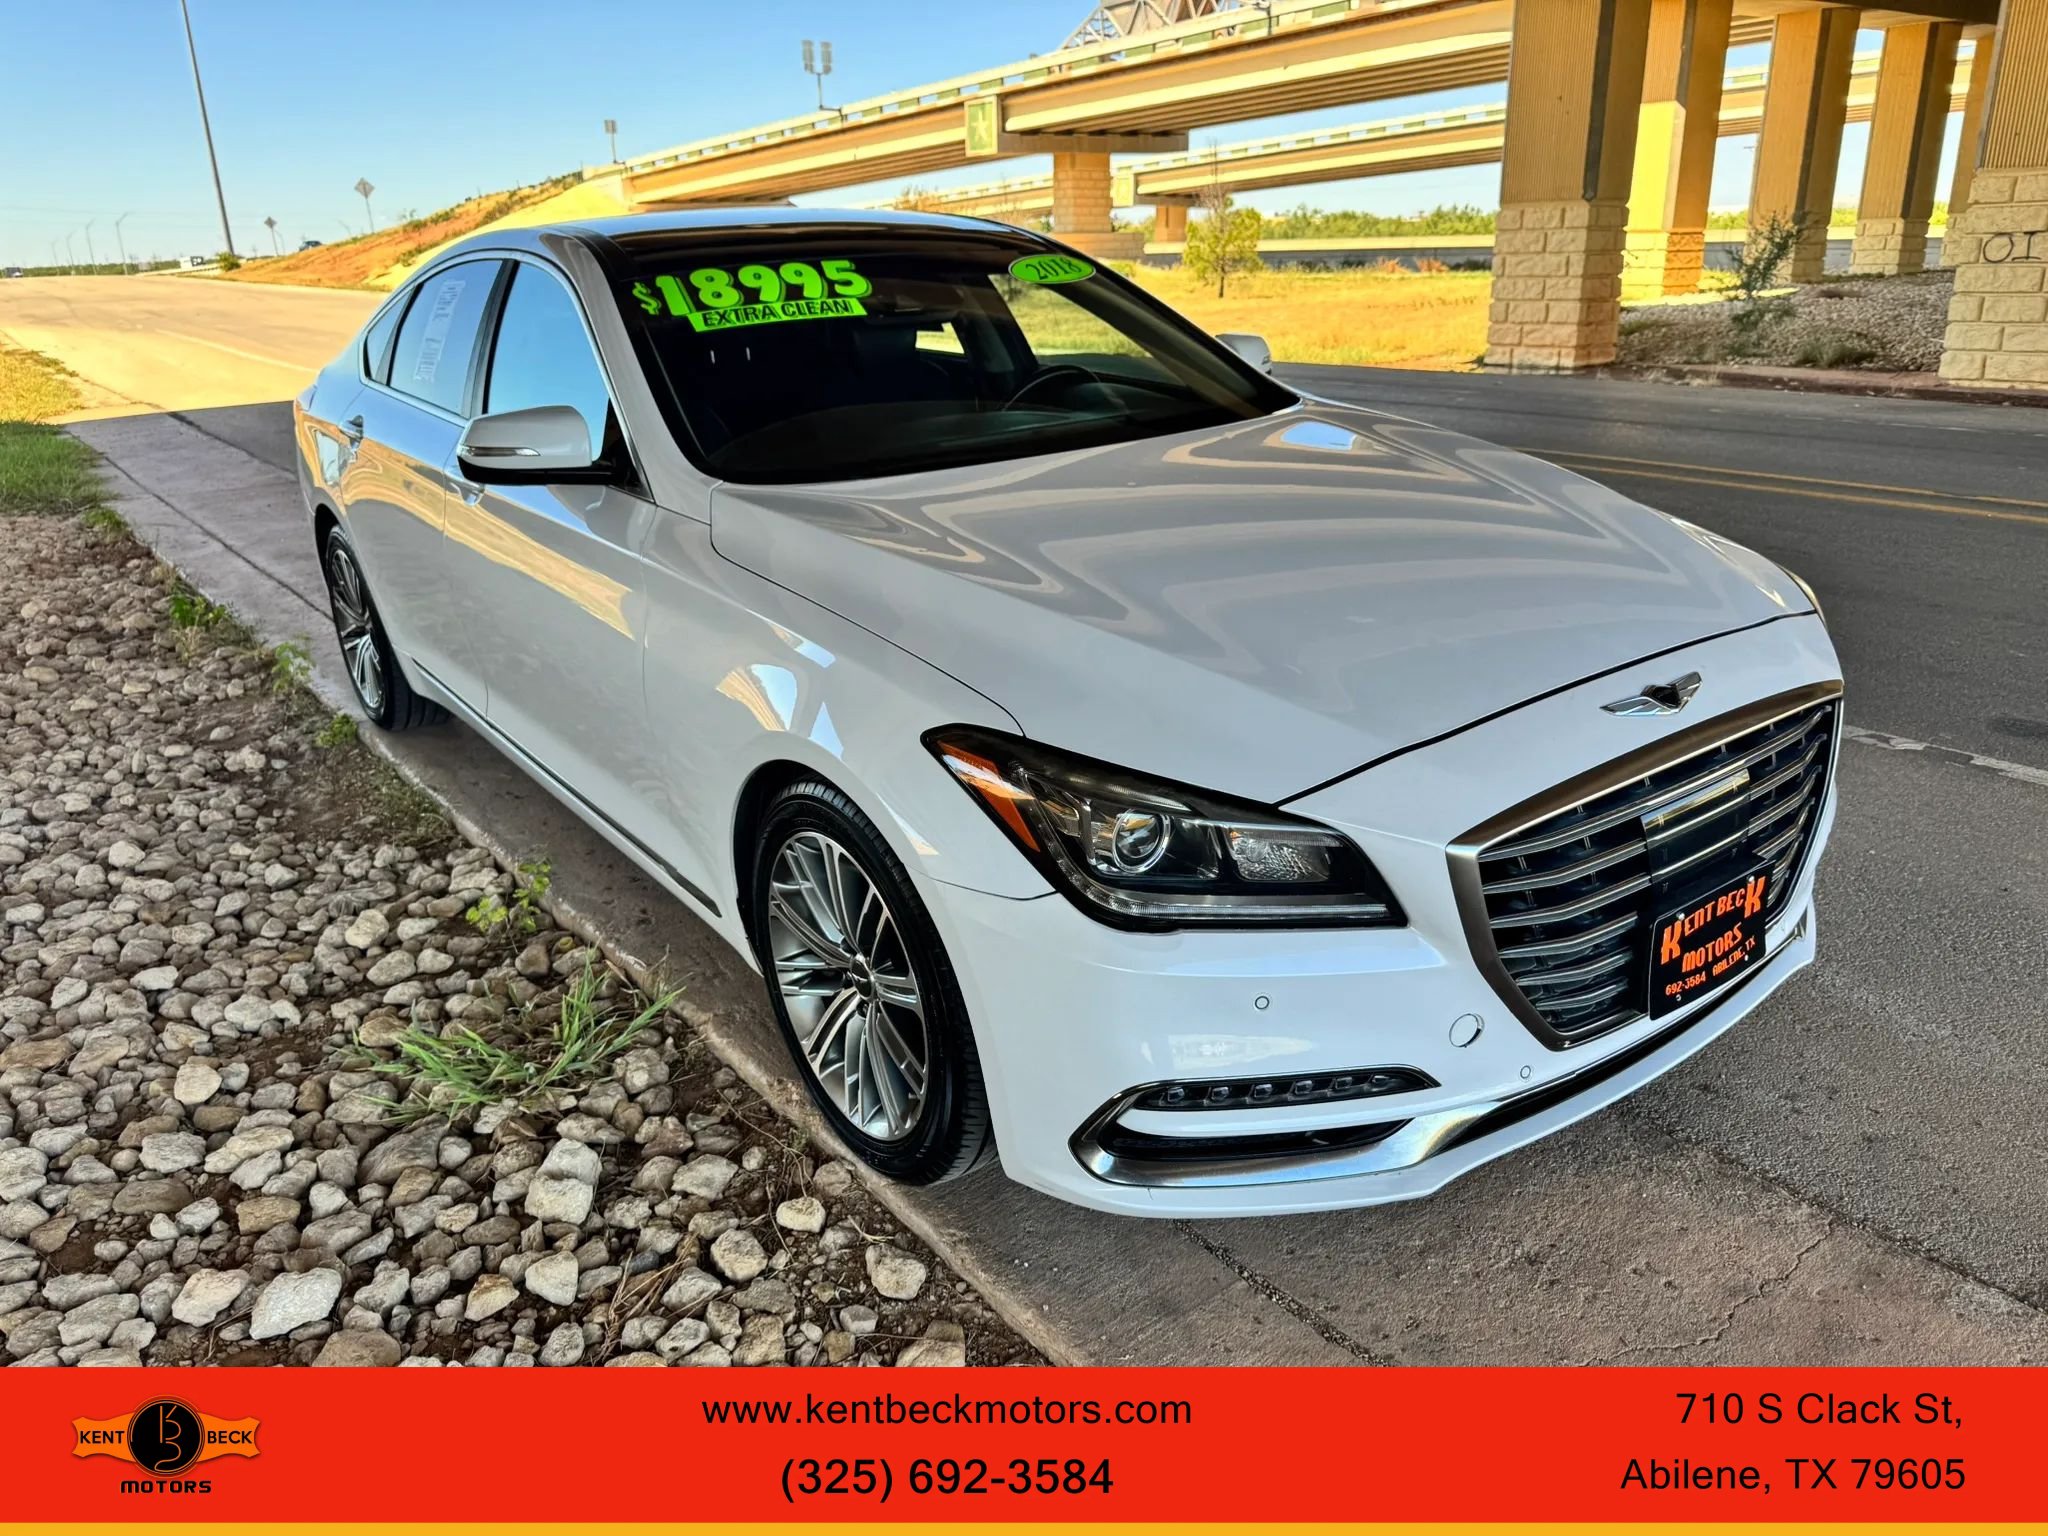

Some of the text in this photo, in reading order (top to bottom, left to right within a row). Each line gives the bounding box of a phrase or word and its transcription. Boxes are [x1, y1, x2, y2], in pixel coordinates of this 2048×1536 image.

[632, 259, 872, 316] $18995
[1025, 257, 1082, 280] 2018
[702, 298, 850, 328] EXTRA CLEAN
[1661, 876, 1766, 965] KENT BECK
[1682, 921, 1743, 973] MOTORS
[1665, 971, 1706, 996] 692-3584
[1745, 935, 1756, 951] TX
